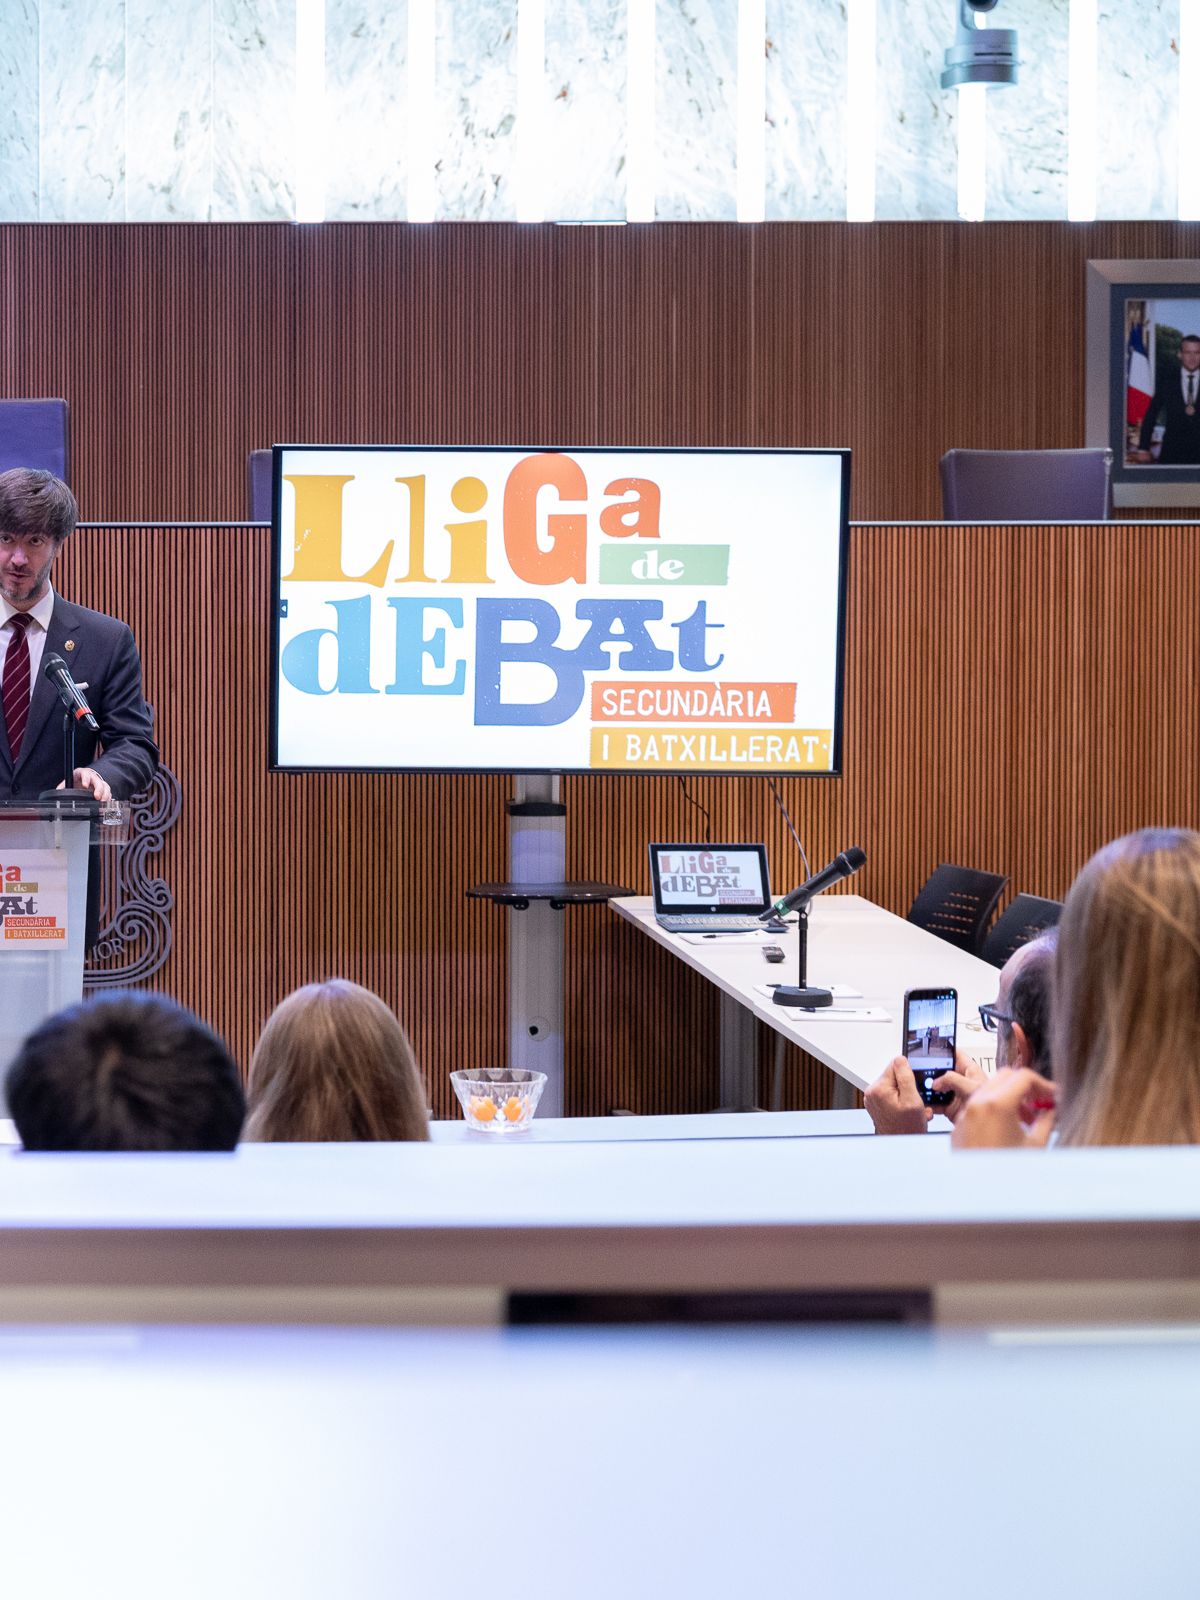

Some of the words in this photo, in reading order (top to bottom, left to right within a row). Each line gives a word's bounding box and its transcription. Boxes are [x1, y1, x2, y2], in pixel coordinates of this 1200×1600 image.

[281, 452, 661, 588] LliGa
[631, 549, 686, 581] de
[281, 594, 725, 726] dEBAt
[601, 682, 772, 718] SECUNDÀRIA
[602, 735, 609, 760] I
[625, 735, 819, 763] BATXILLERAT
[13, 883, 27, 893] de
